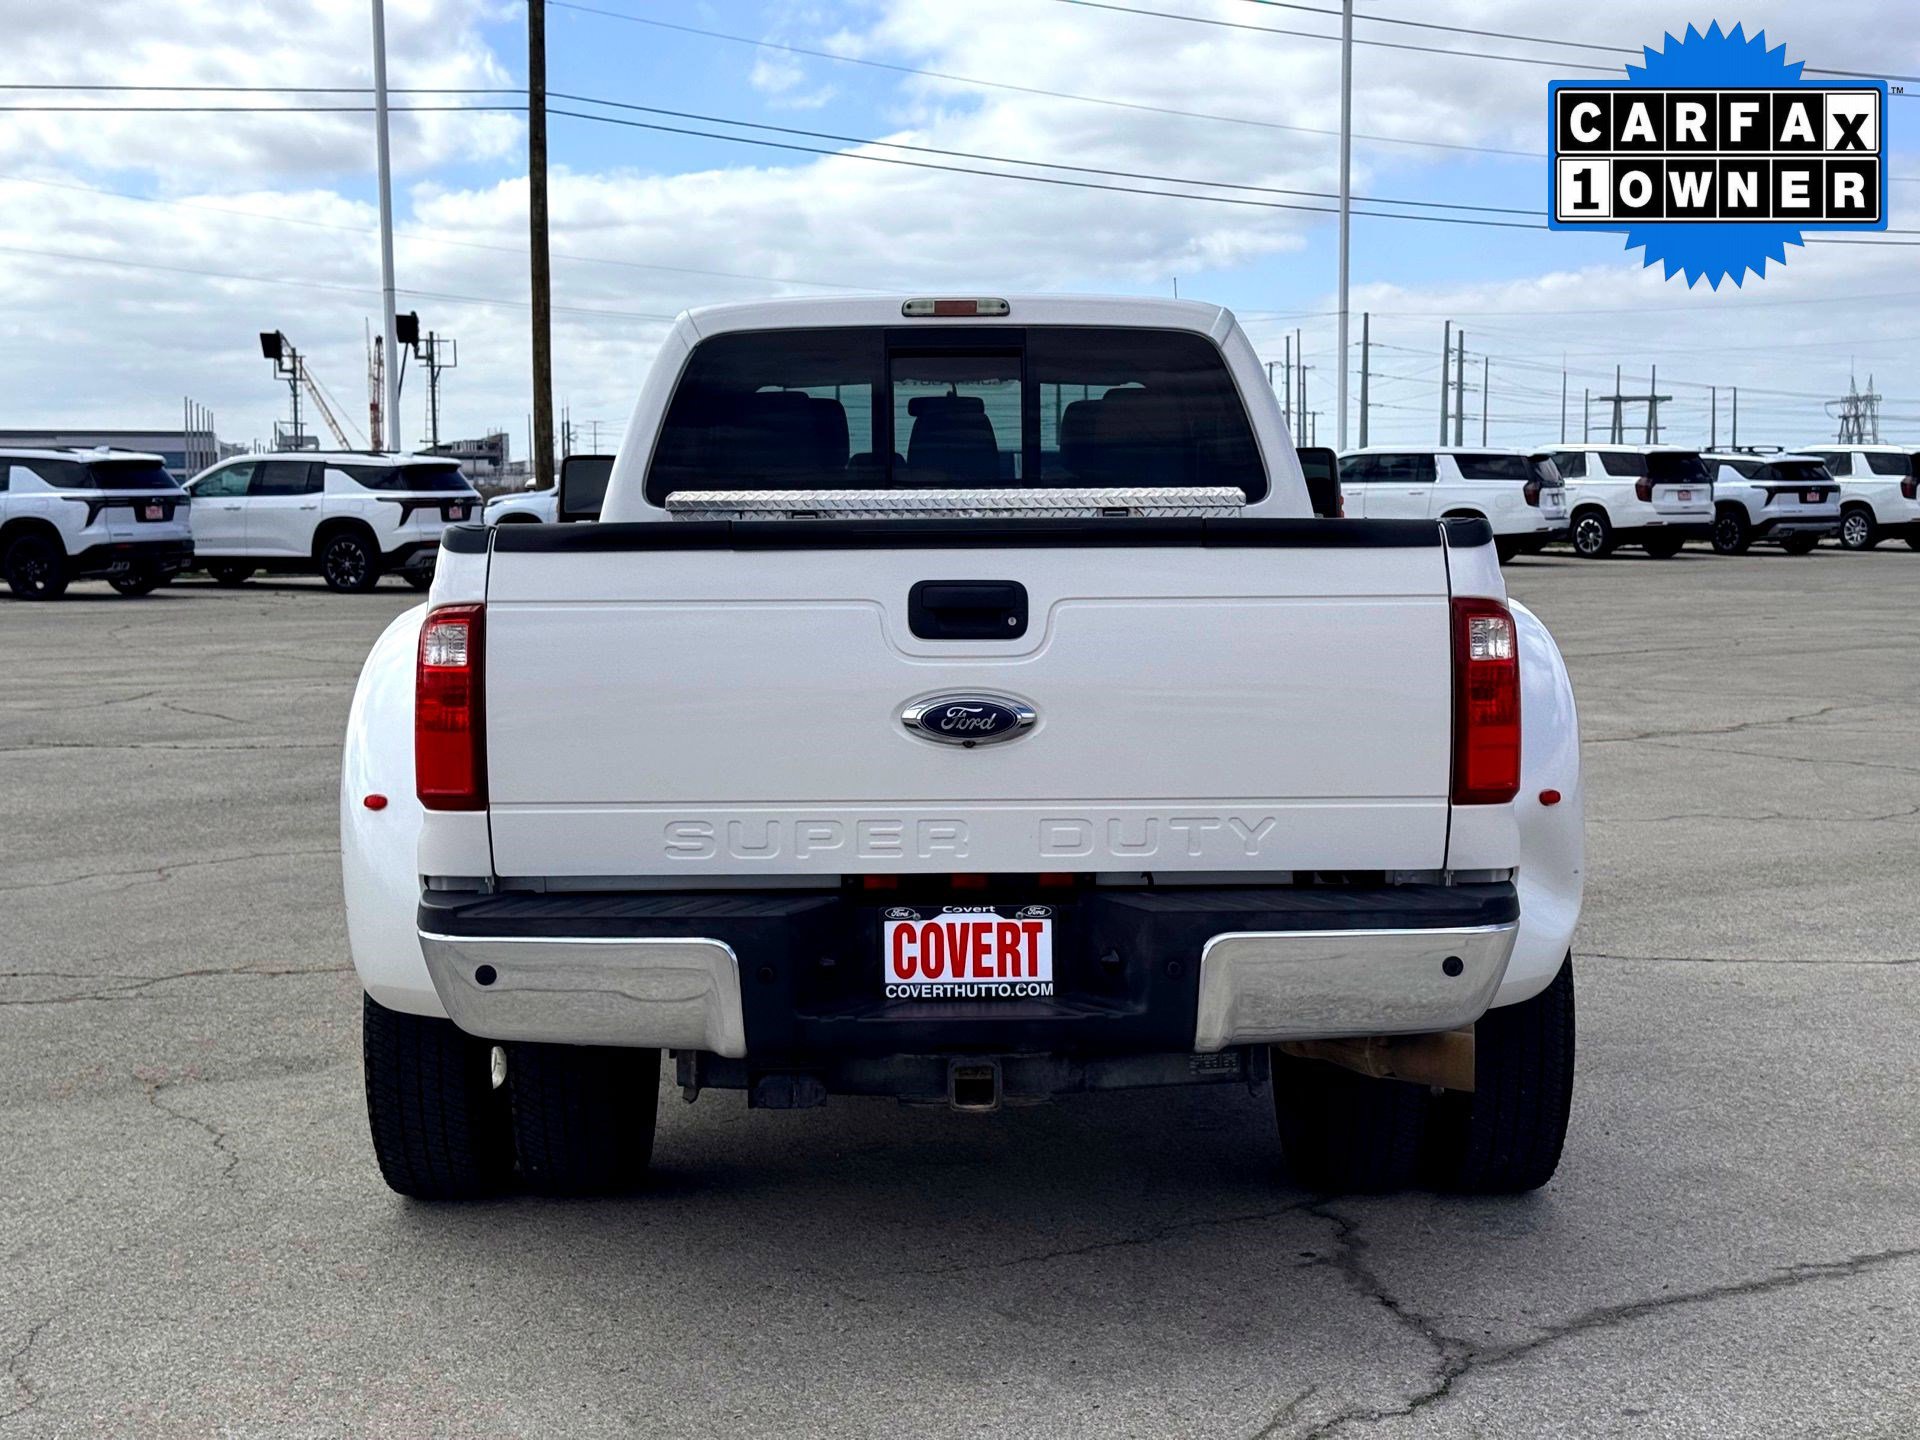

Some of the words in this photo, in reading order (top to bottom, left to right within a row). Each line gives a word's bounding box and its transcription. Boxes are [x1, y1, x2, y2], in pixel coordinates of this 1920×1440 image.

[940, 706, 997, 730] Ford
[663, 819, 971, 860] SUPER
[1038, 816, 1277, 857] DUTY
[890, 907, 910, 917] Ford
[942, 905, 996, 914] Covert
[1026, 906, 1047, 916] Ford
[893, 921, 1043, 980] COVERT
[885, 983, 1054, 998] COVERTHUTTO.COM
